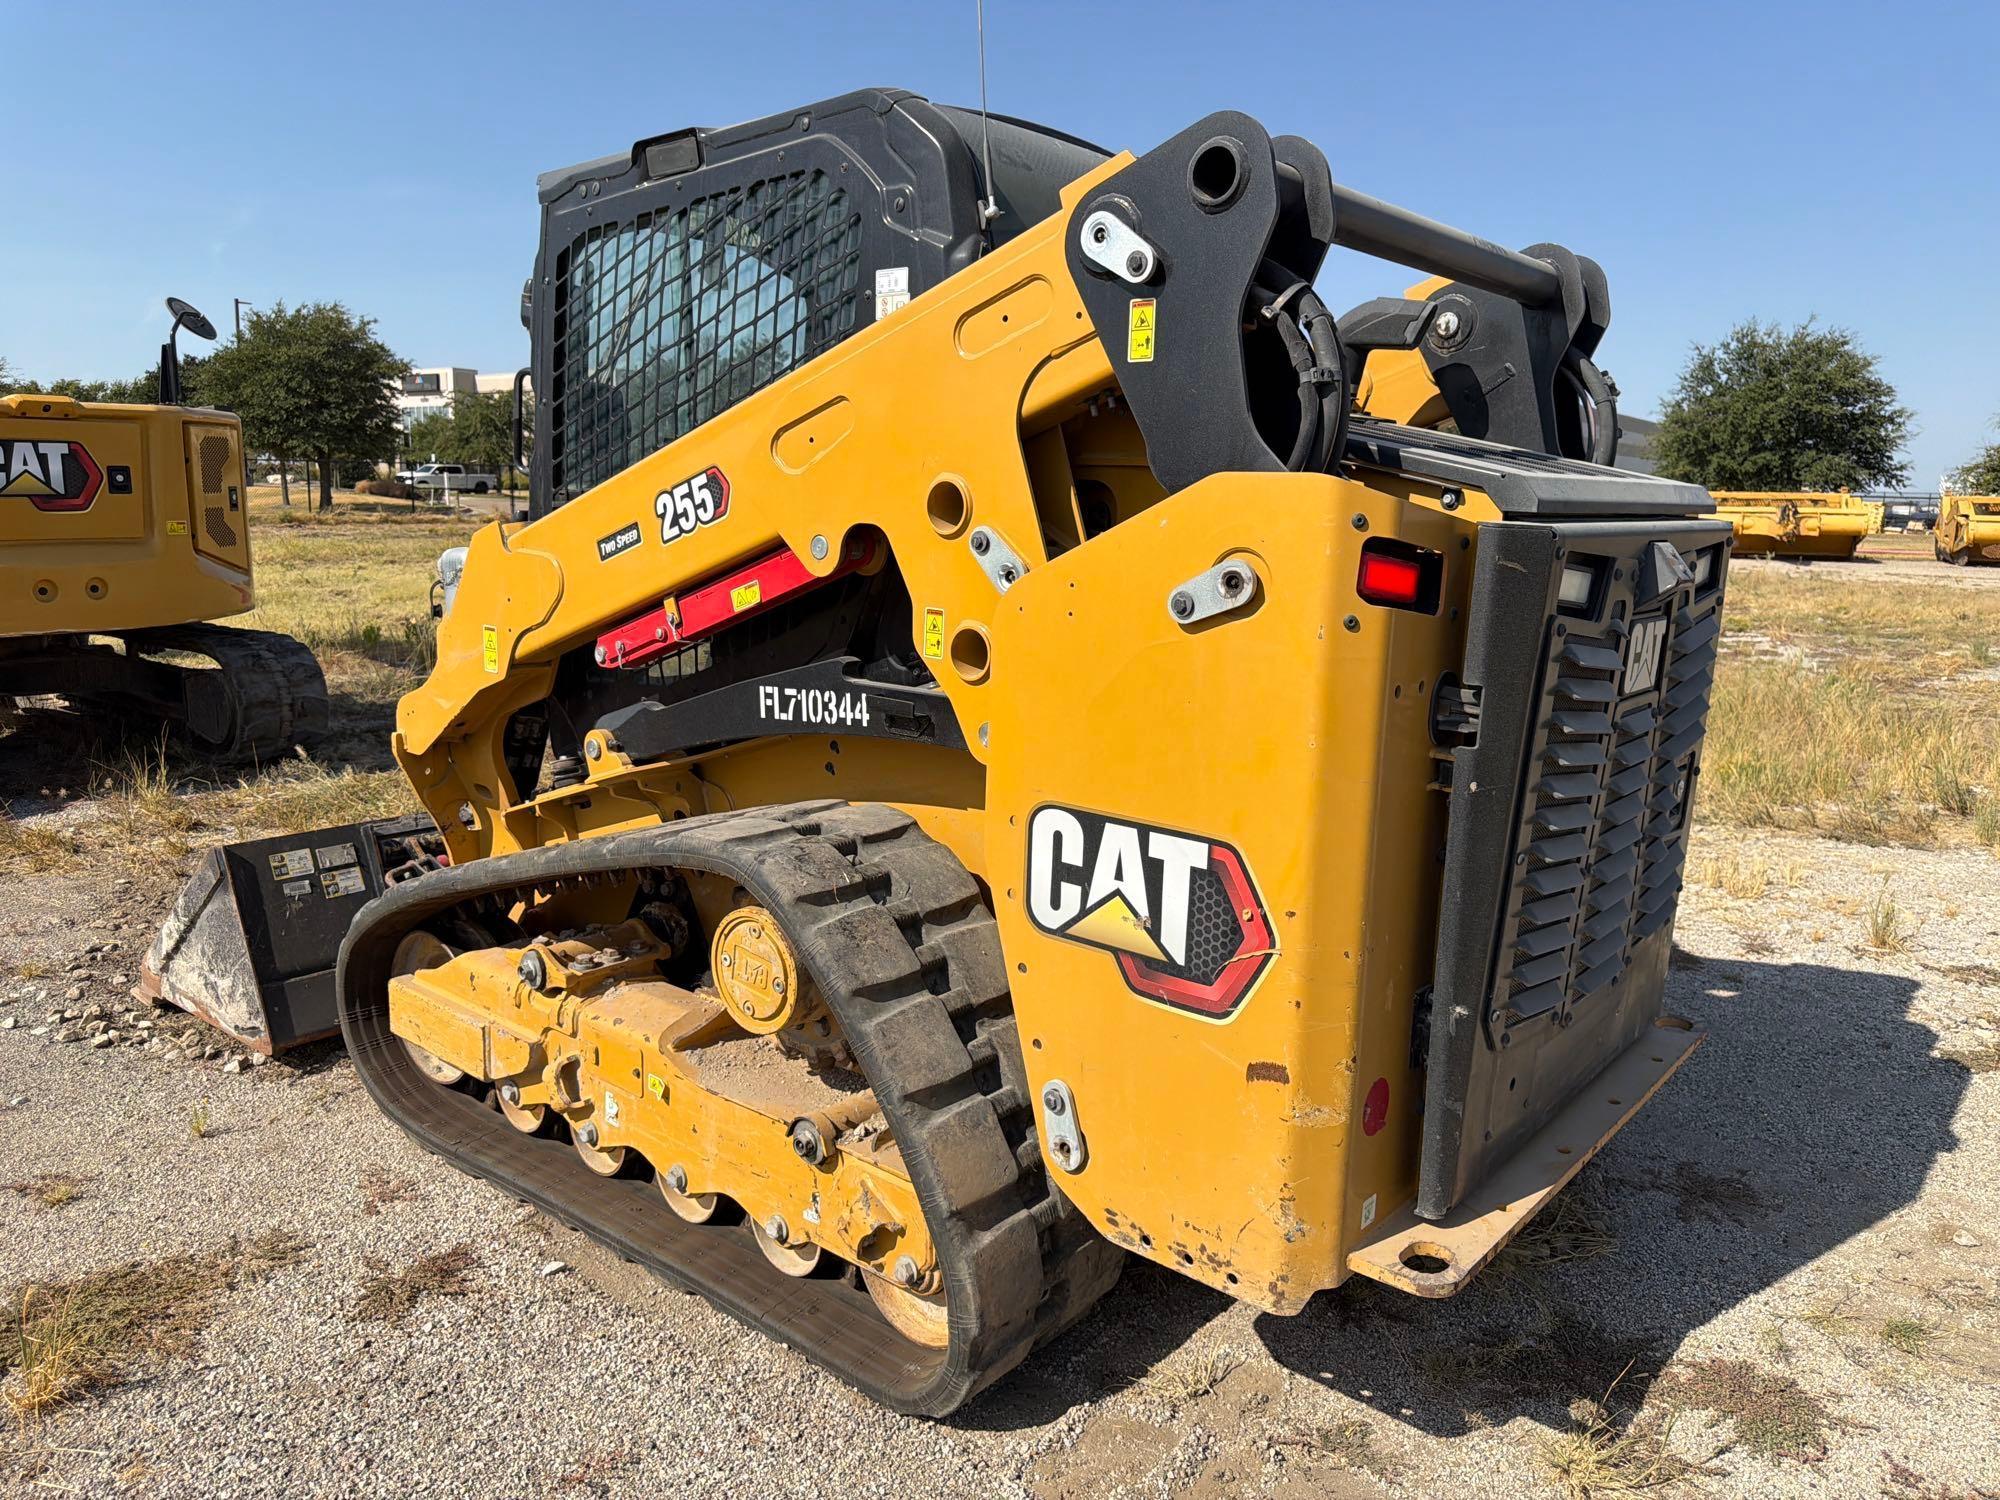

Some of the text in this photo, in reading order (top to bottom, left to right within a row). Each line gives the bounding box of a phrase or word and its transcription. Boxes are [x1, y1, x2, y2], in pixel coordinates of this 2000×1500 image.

[0, 441, 69, 495] AT
[656, 472, 714, 541] 255
[1624, 620, 1668, 694] CAT
[759, 685, 870, 727] FL710344
[1029, 808, 1209, 967] CAT
